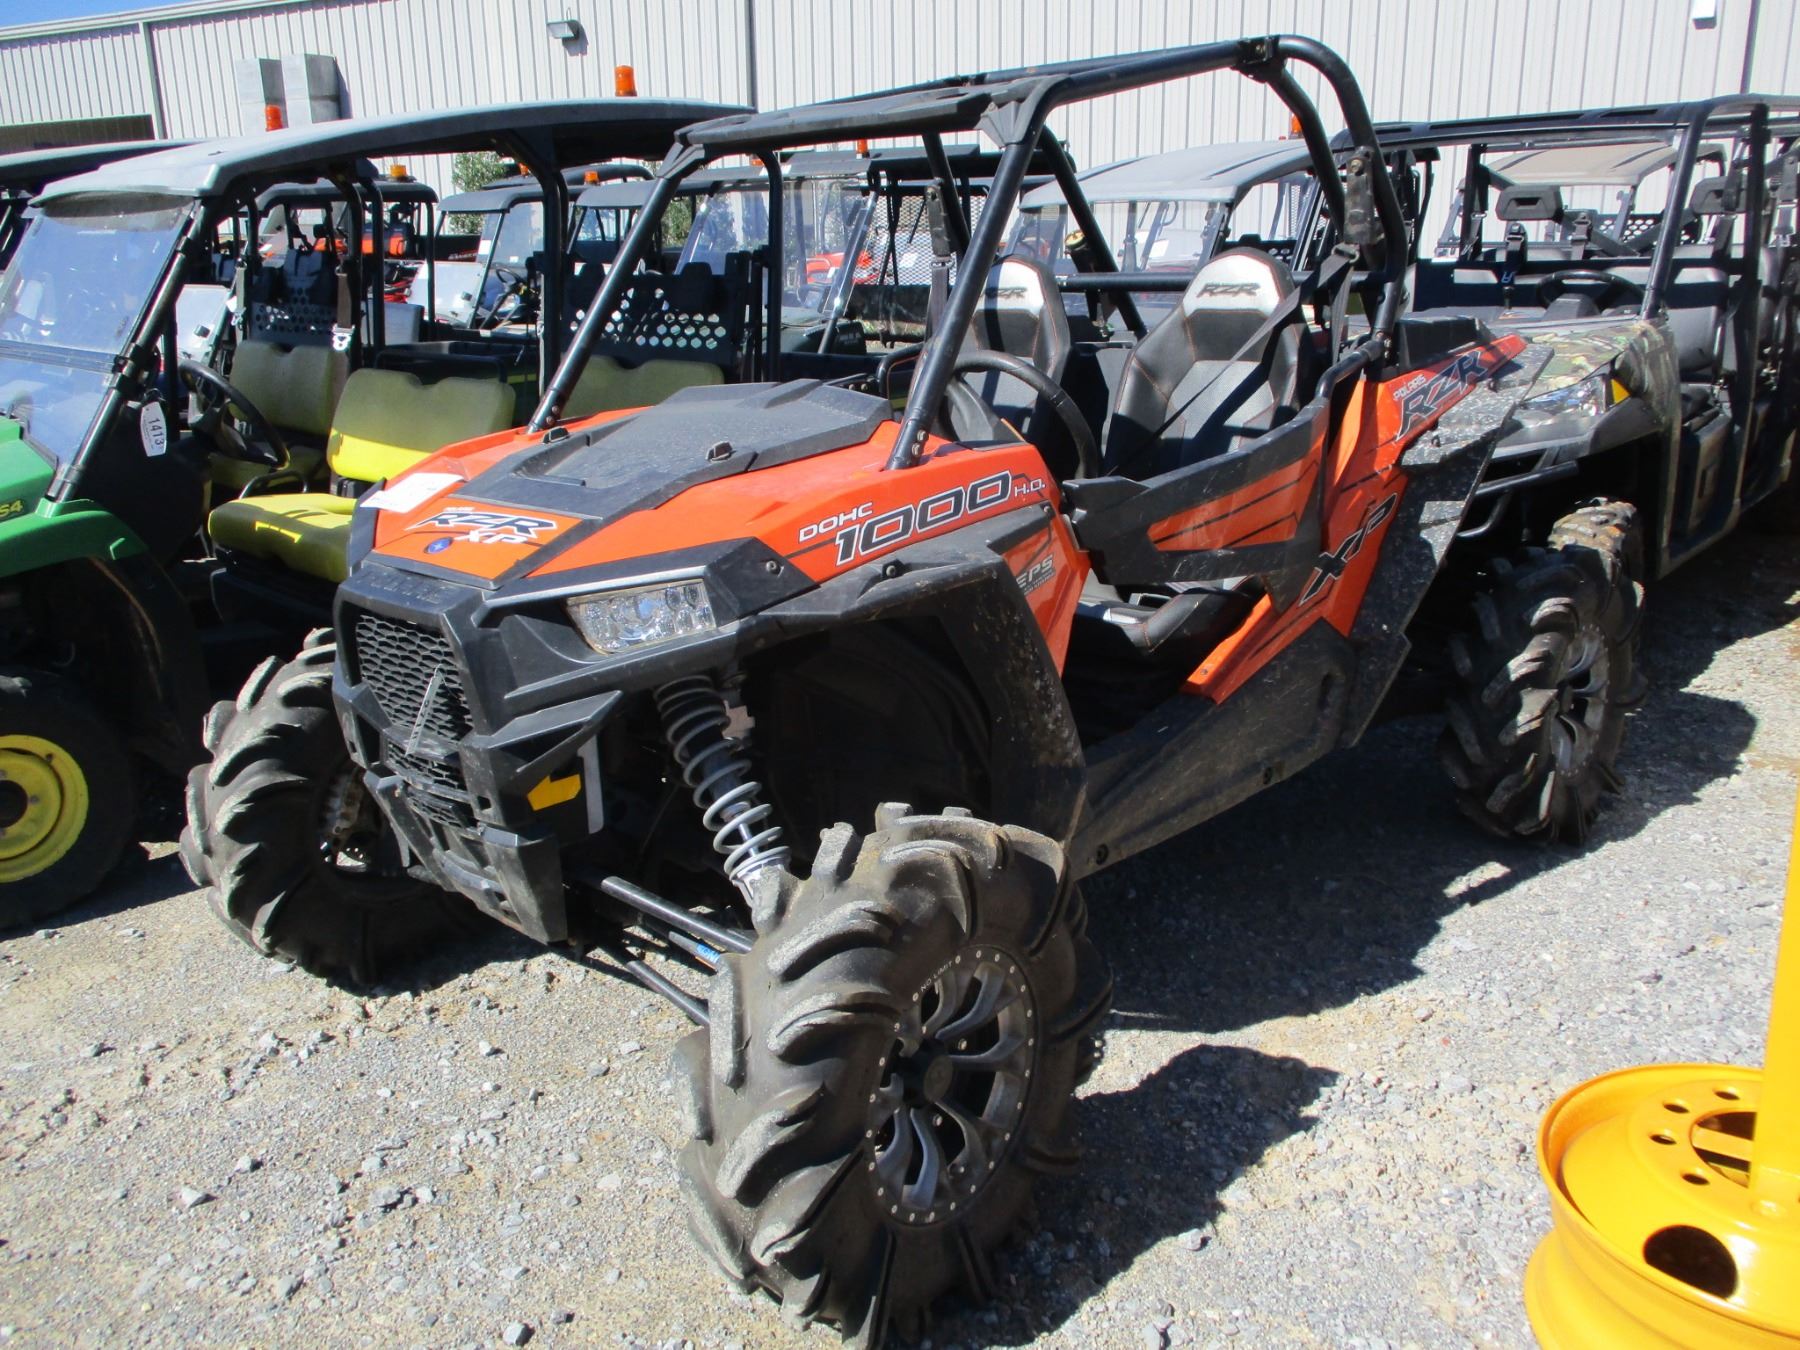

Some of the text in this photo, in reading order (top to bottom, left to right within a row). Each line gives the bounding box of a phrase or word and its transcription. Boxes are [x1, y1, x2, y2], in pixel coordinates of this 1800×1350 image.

[1196, 281, 1260, 298] RZR
[1393, 374, 1427, 402] POLARIS
[1395, 349, 1488, 441] RZR
[148, 417, 165, 446] 1413
[404, 511, 558, 539] RZR
[798, 502, 873, 543] DOHC
[835, 470, 1012, 567] 1000
[453, 529, 529, 544] XP
[1298, 492, 1398, 607] XP
[1015, 554, 1054, 589] EPS
